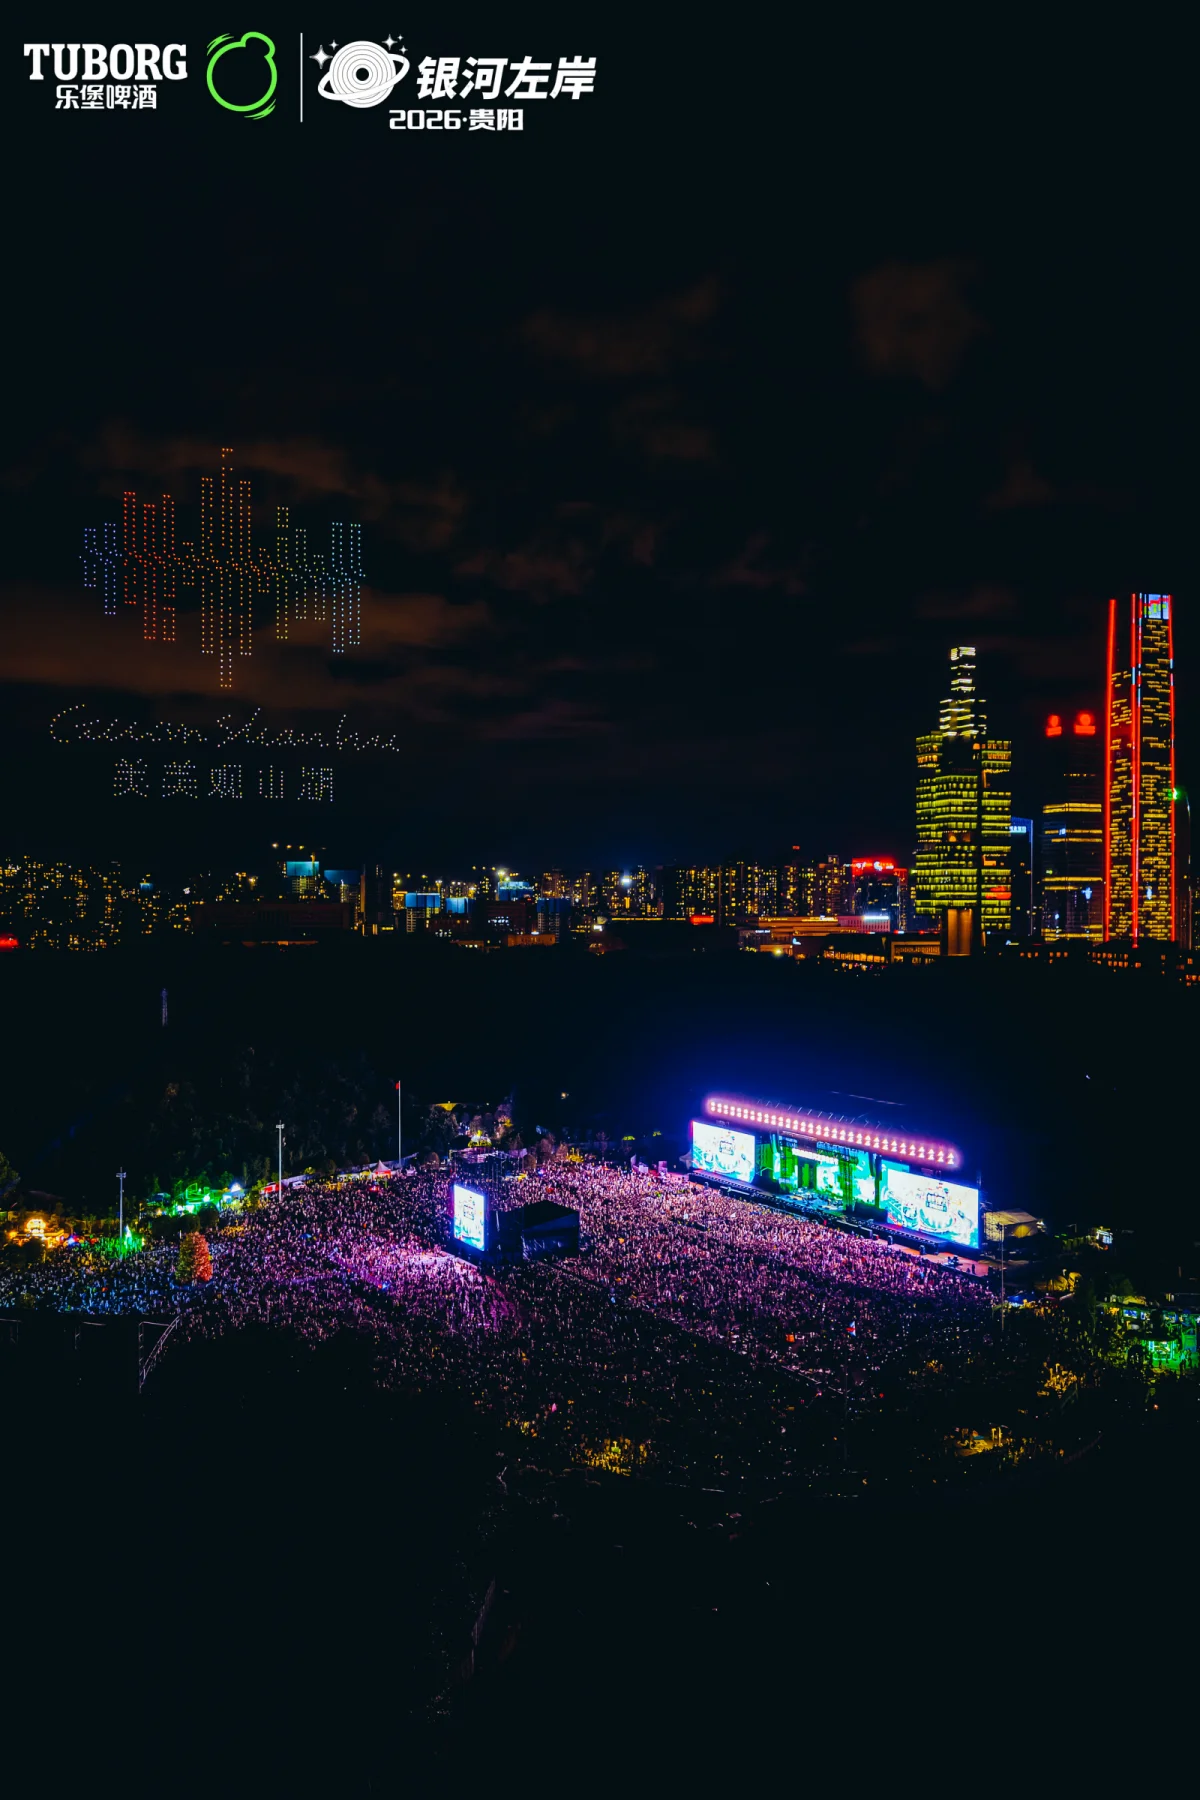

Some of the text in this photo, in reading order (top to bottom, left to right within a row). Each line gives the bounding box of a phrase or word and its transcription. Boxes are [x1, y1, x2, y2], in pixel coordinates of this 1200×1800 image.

[113, 758, 334, 802] 美美观山湖
